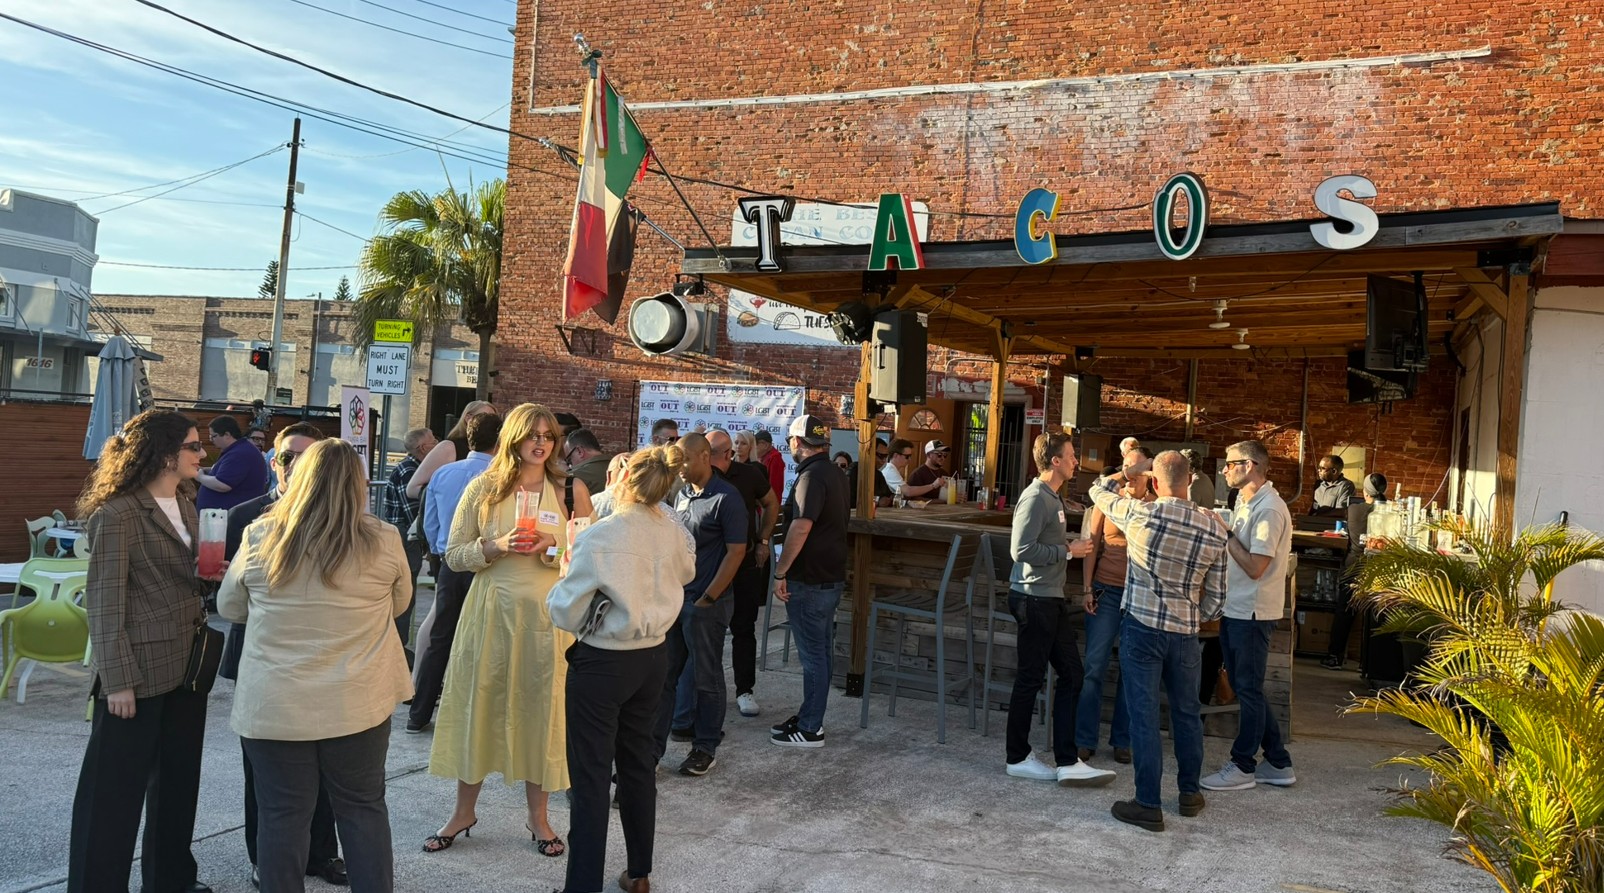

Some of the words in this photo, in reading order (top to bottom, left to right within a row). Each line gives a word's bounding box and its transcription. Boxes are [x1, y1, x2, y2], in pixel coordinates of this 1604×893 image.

[738, 171, 1380, 273] TACOS
[804, 315, 830, 329] TUES
[371, 351, 387, 359] RIGHT
[391, 352, 406, 360] LANE
[376, 365, 398, 375] MUST
[368, 379, 383, 387] TURN
[387, 380, 404, 388] RIGHT
[650, 384, 669, 392] OUT
[766, 389, 785, 397] OUT
[660, 402, 679, 410] OUT
[717, 405, 737, 413] OUT
[776, 408, 796, 416] OUT
[677, 421, 690, 429] UT
